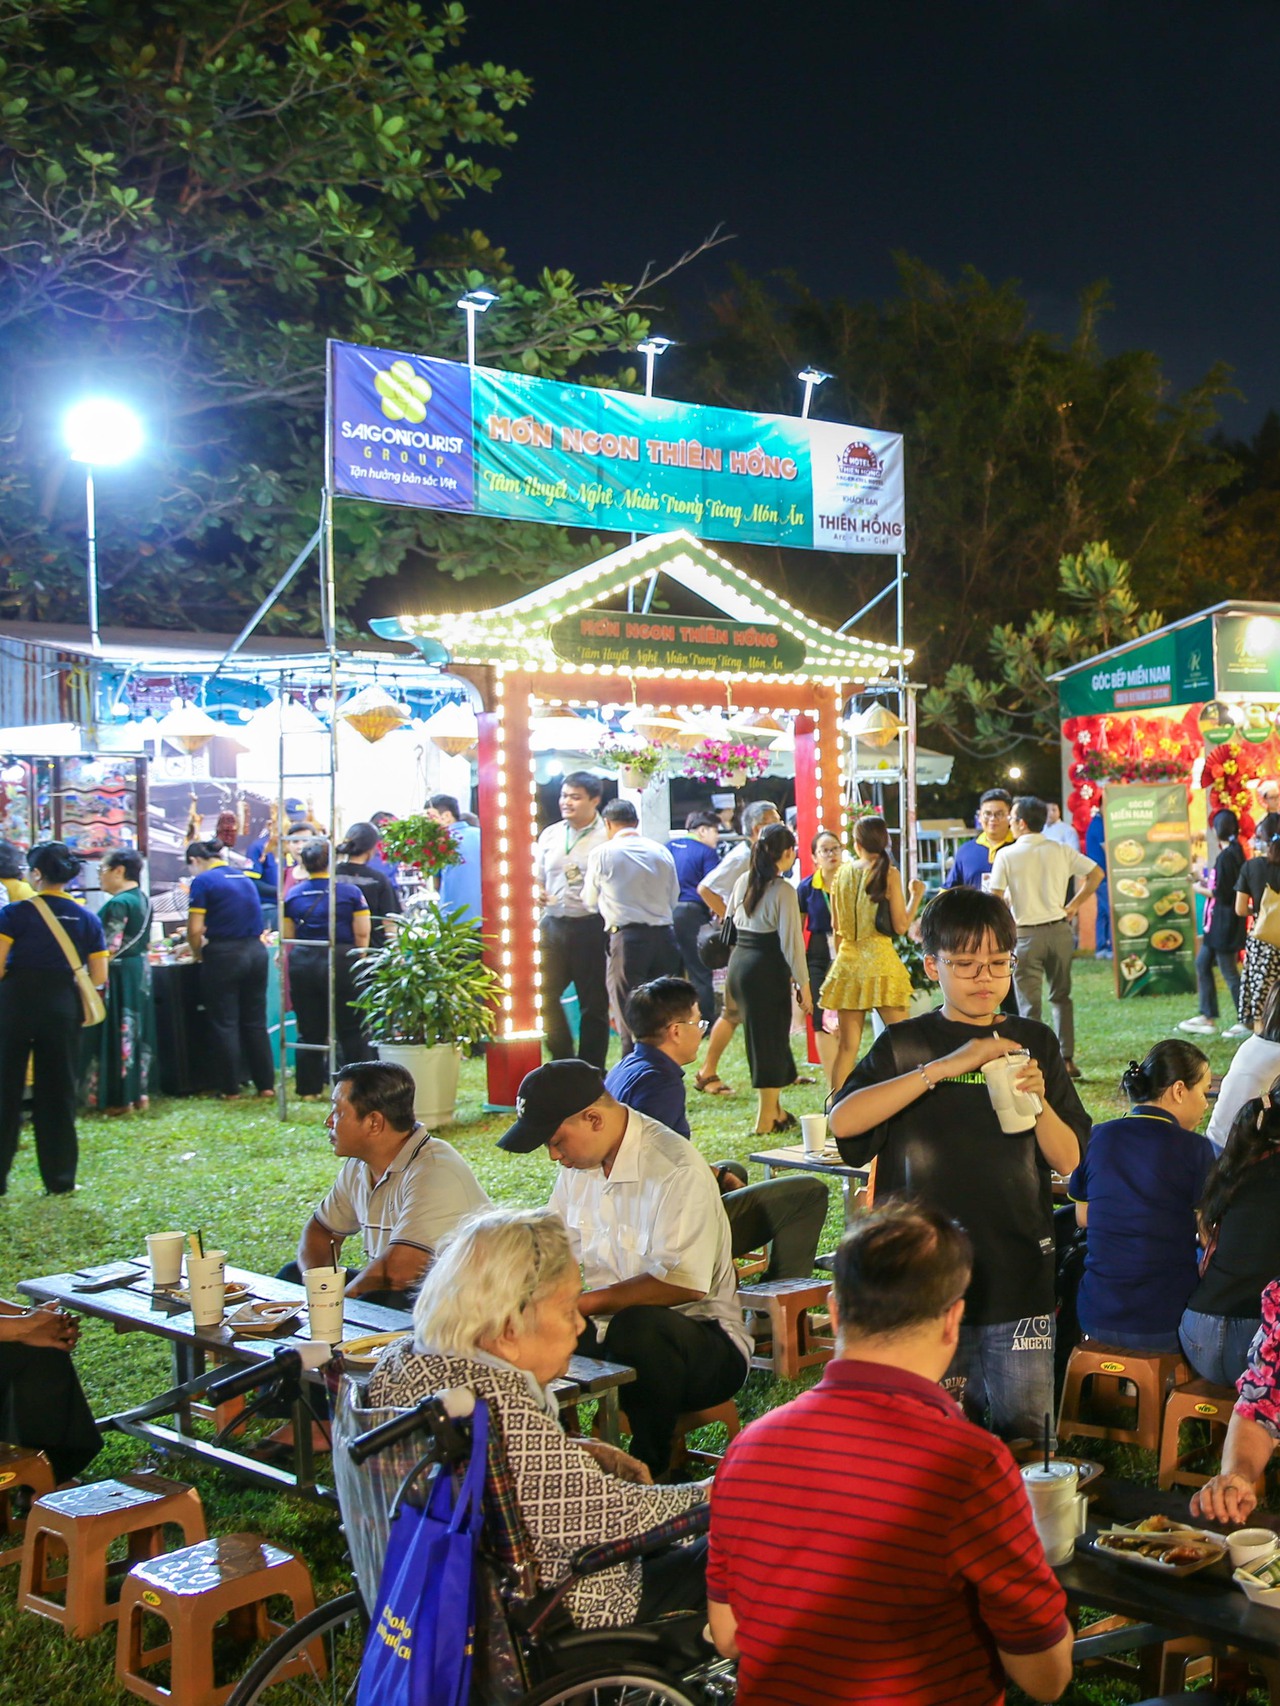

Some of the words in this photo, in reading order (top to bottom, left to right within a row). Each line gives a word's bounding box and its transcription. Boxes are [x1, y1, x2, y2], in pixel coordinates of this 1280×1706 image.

[341, 421, 464, 454] SAIGONTOURIST
[488, 415, 553, 449] MÓN
[561, 426, 640, 461] NGON
[646, 438, 722, 472] THIÊN
[730, 442, 798, 480] HỒNG
[363, 446, 444, 468] GROUP
[484, 470, 521, 492] Tâm
[661, 493, 705, 524] Trong
[744, 503, 780, 523] Món
[819, 514, 857, 532] THIÊN
[625, 622, 675, 642] NGON
[680, 625, 729, 645] THIÊN
[1092, 671, 1111, 691] GÓC
[1149, 664, 1171, 684] NAM
